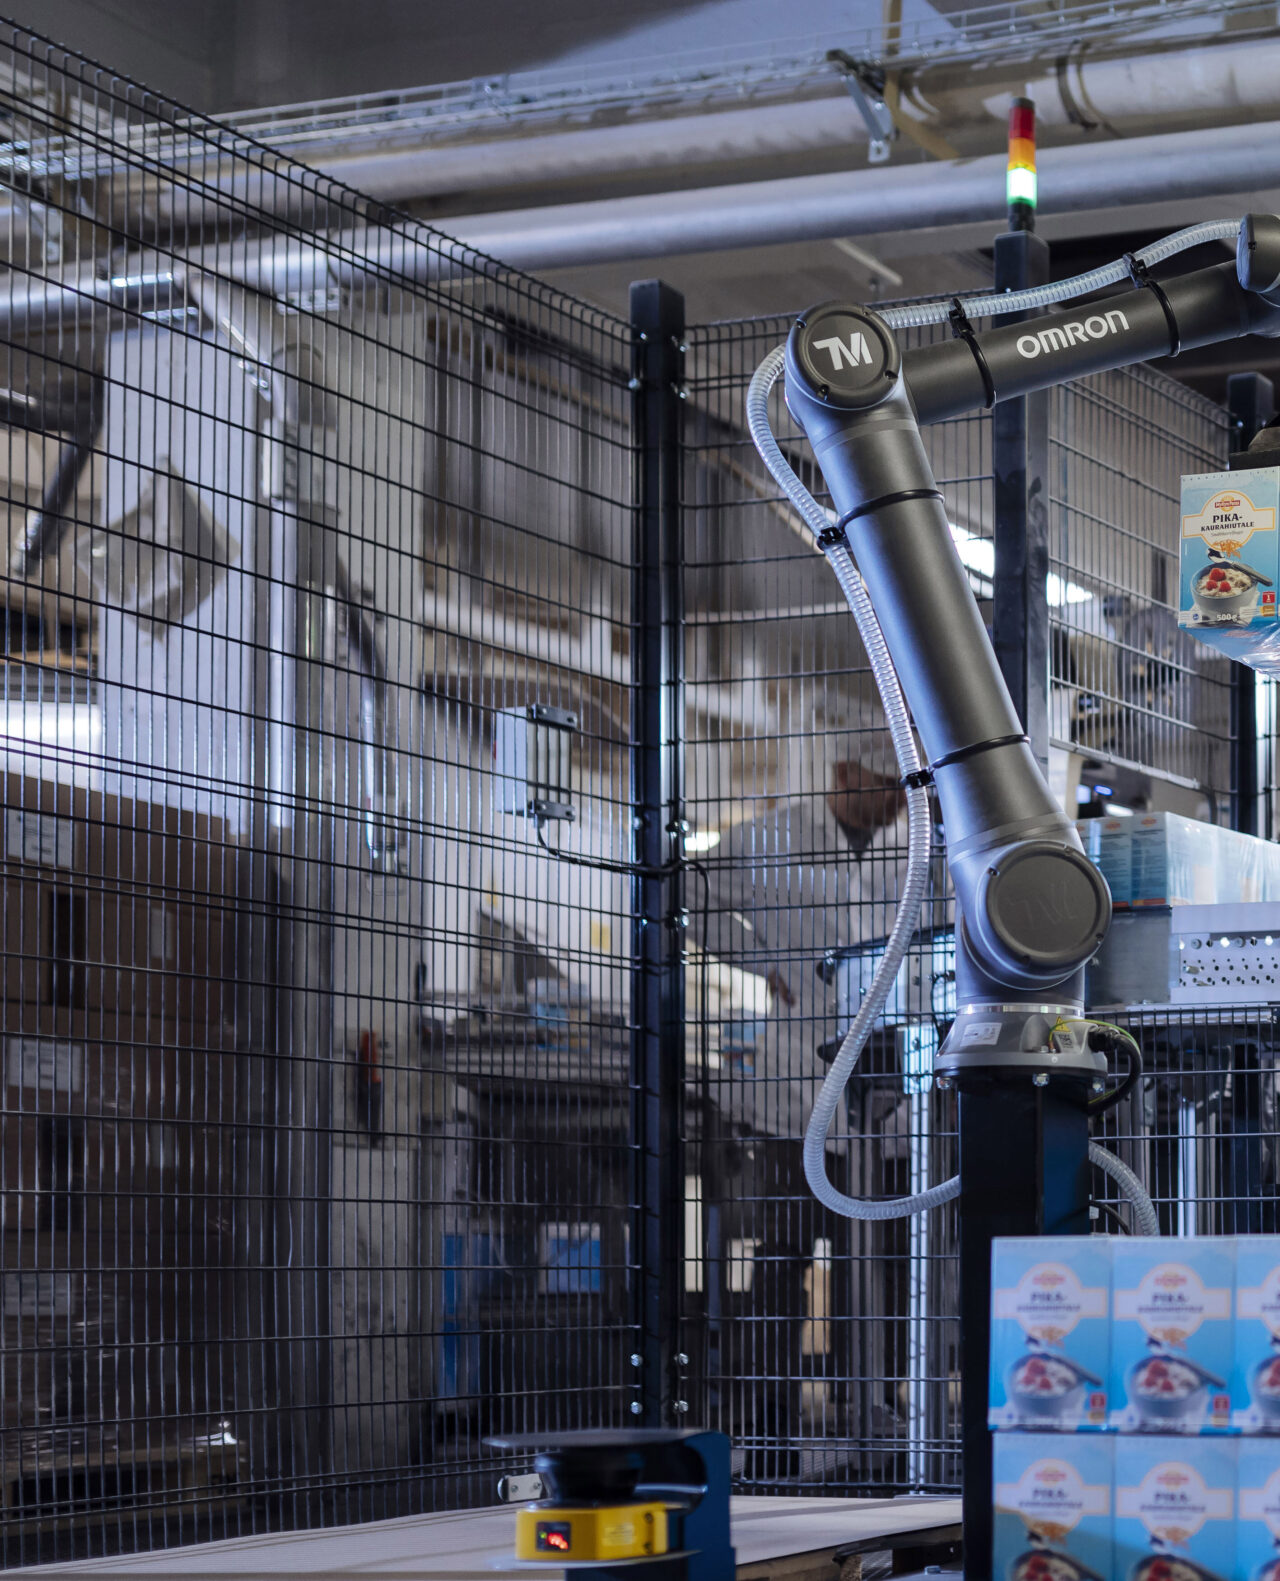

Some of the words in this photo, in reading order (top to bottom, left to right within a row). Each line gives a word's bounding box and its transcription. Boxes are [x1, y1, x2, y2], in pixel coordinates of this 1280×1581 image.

[812, 331, 873, 371] TM
[1212, 513, 1243, 523] PIKA-
[1201, 521, 1254, 532] KAURAHIUTALE
[1216, 613, 1231, 621] 500
